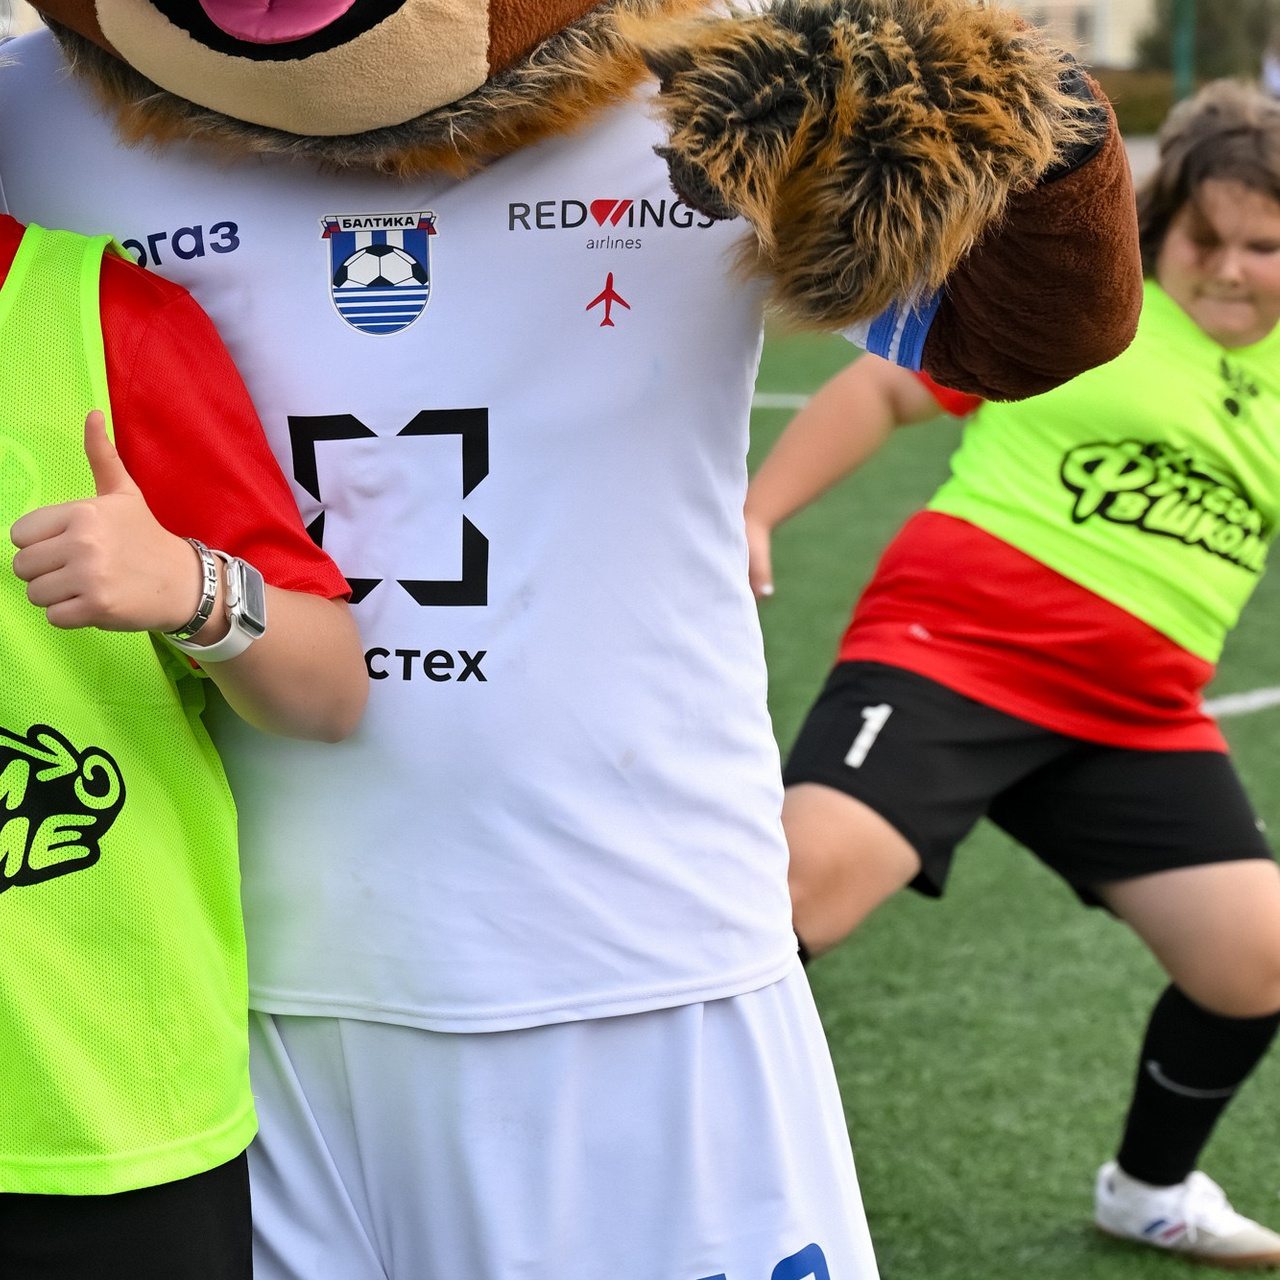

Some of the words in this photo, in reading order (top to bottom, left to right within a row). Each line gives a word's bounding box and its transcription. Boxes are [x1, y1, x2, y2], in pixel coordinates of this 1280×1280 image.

[342, 216, 415, 229] БАЛТИКА
[121, 221, 240, 269] огаз
[586, 235, 642, 250] airlines
[364, 647, 488, 682] стех
[844, 703, 894, 769] 1
